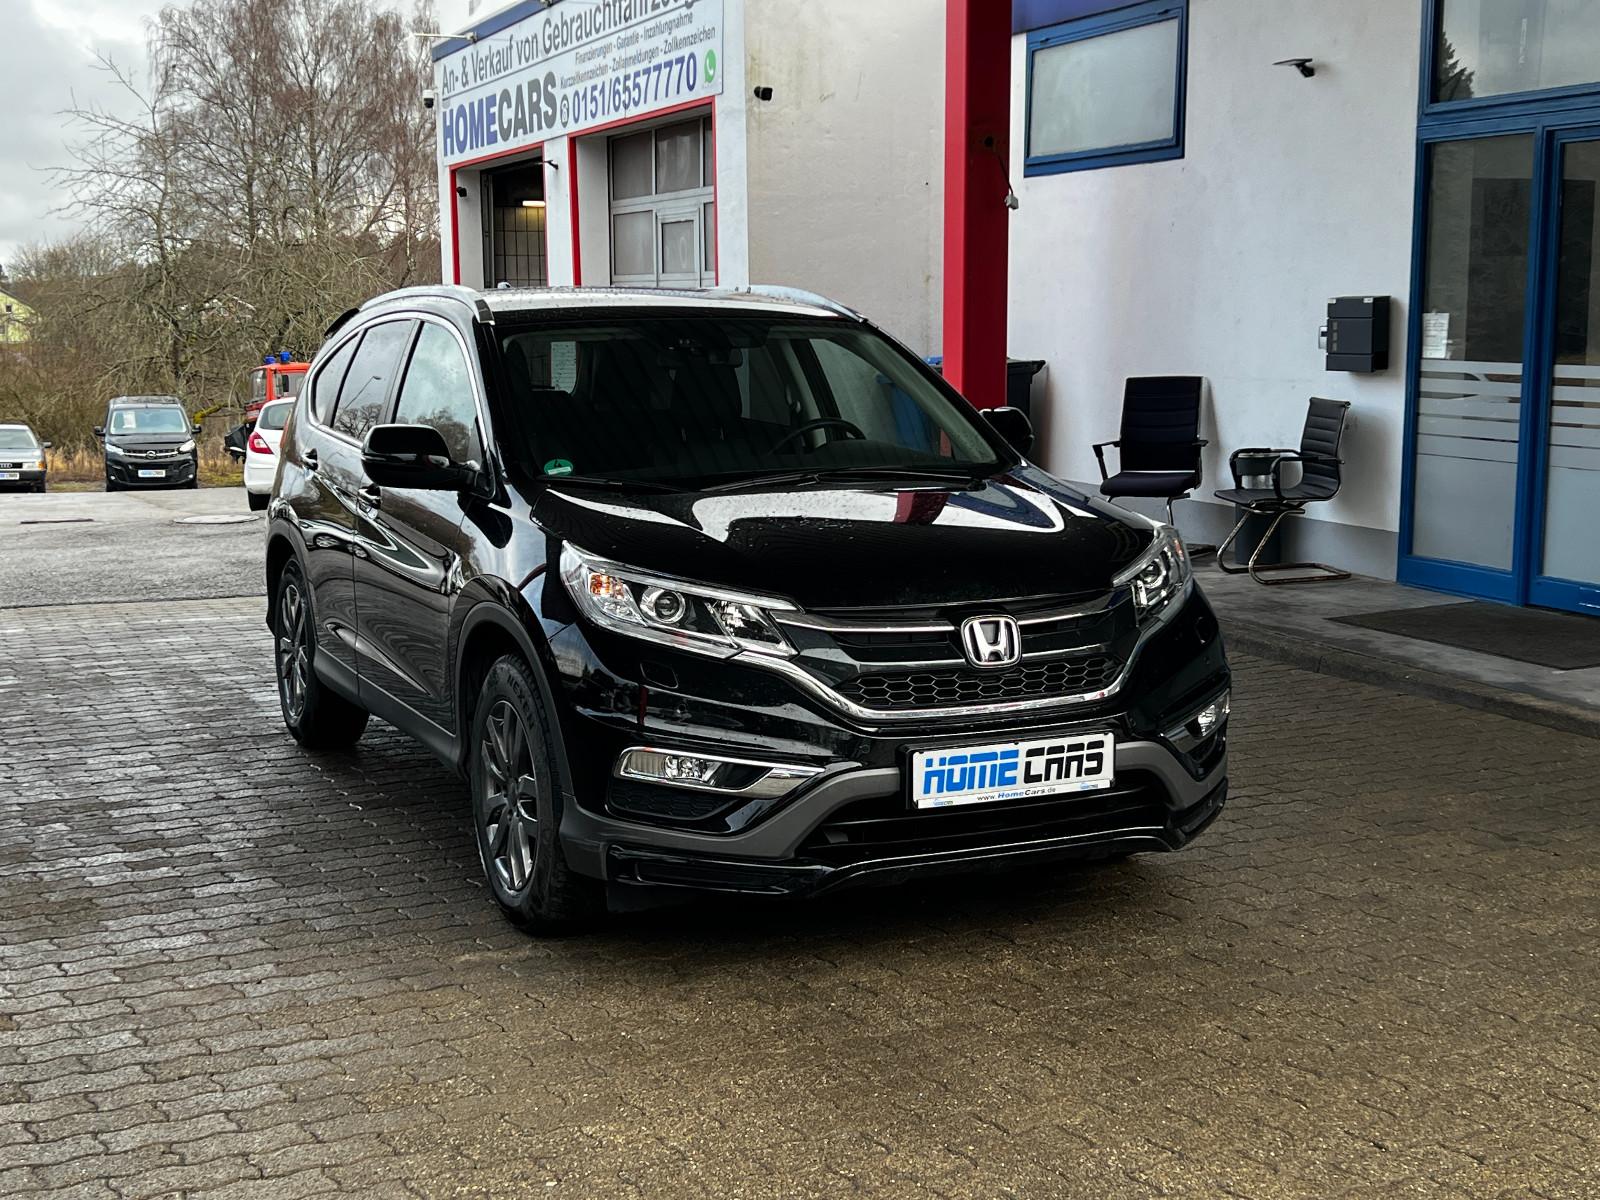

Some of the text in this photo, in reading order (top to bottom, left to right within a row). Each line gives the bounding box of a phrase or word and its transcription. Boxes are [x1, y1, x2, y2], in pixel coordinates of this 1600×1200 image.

[644, 12, 693, 40] Inzahlungnahme
[664, 26, 716, 55] Zollkennzeichen
[442, 0, 695, 96] An- & Verkauf von Gebrauchtfahr
[572, 52, 697, 124] 0151/65577770
[923, 740, 1104, 794] HOME CARS
[977, 786, 1056, 801] www.HomeCars.de
